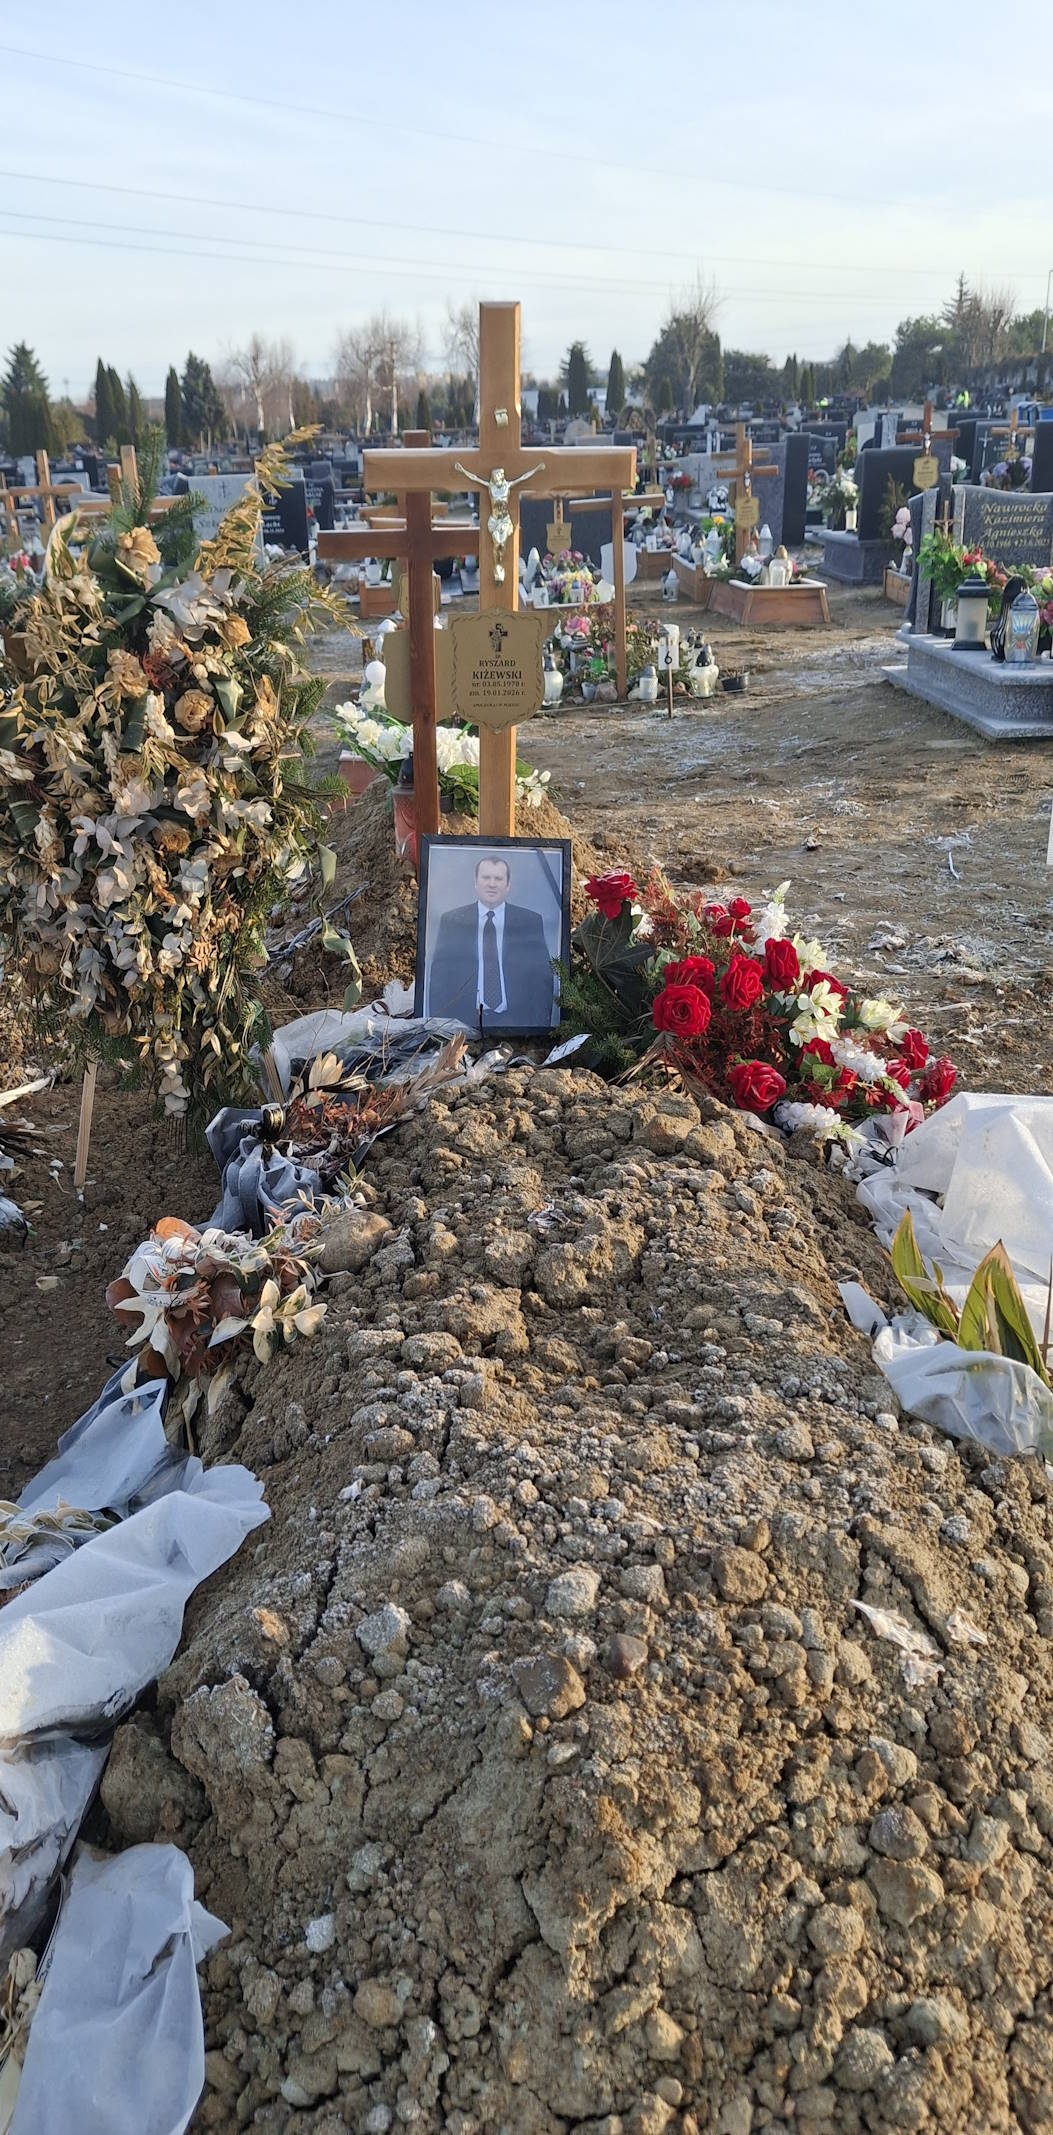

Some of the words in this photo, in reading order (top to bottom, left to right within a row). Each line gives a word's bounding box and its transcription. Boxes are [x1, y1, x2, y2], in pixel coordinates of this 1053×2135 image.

[981, 501, 1048, 514] Nawrocka
[983, 513, 1045, 525] Kazimiera
[980, 525, 1044, 539] Agnieszka
[479, 659, 516, 667] RYSZARD
[472, 669, 522, 680] KIŻEWSKI
